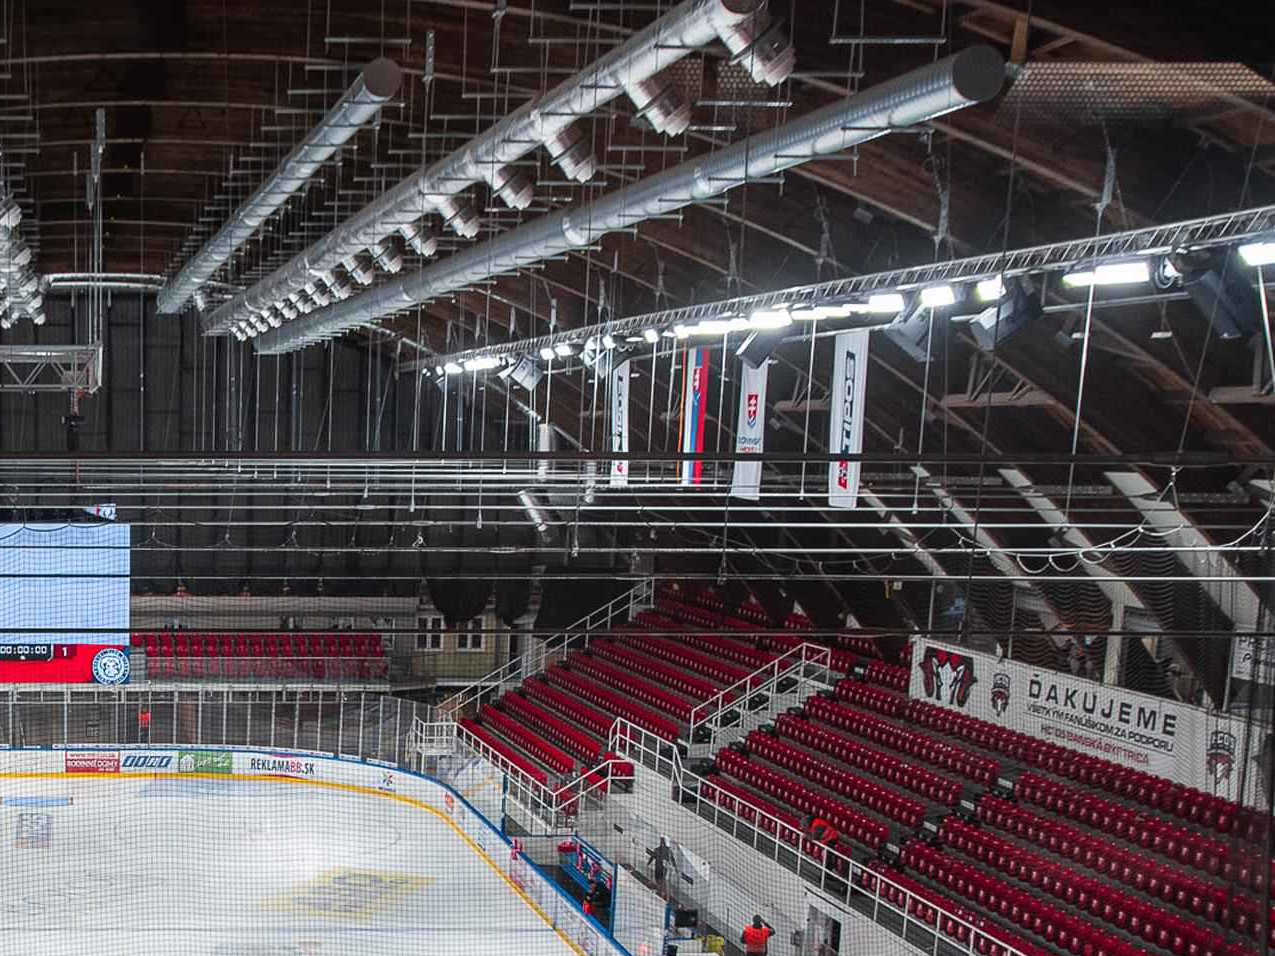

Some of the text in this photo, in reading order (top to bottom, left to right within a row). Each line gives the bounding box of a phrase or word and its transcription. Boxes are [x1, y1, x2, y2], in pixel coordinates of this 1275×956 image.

[62, 647, 68, 657] 1
[1028, 673, 1177, 737] ĎAKUJEME
[1128, 731, 1174, 752] PODPORU
[250, 757, 316, 775] REKLAMABB.SK
